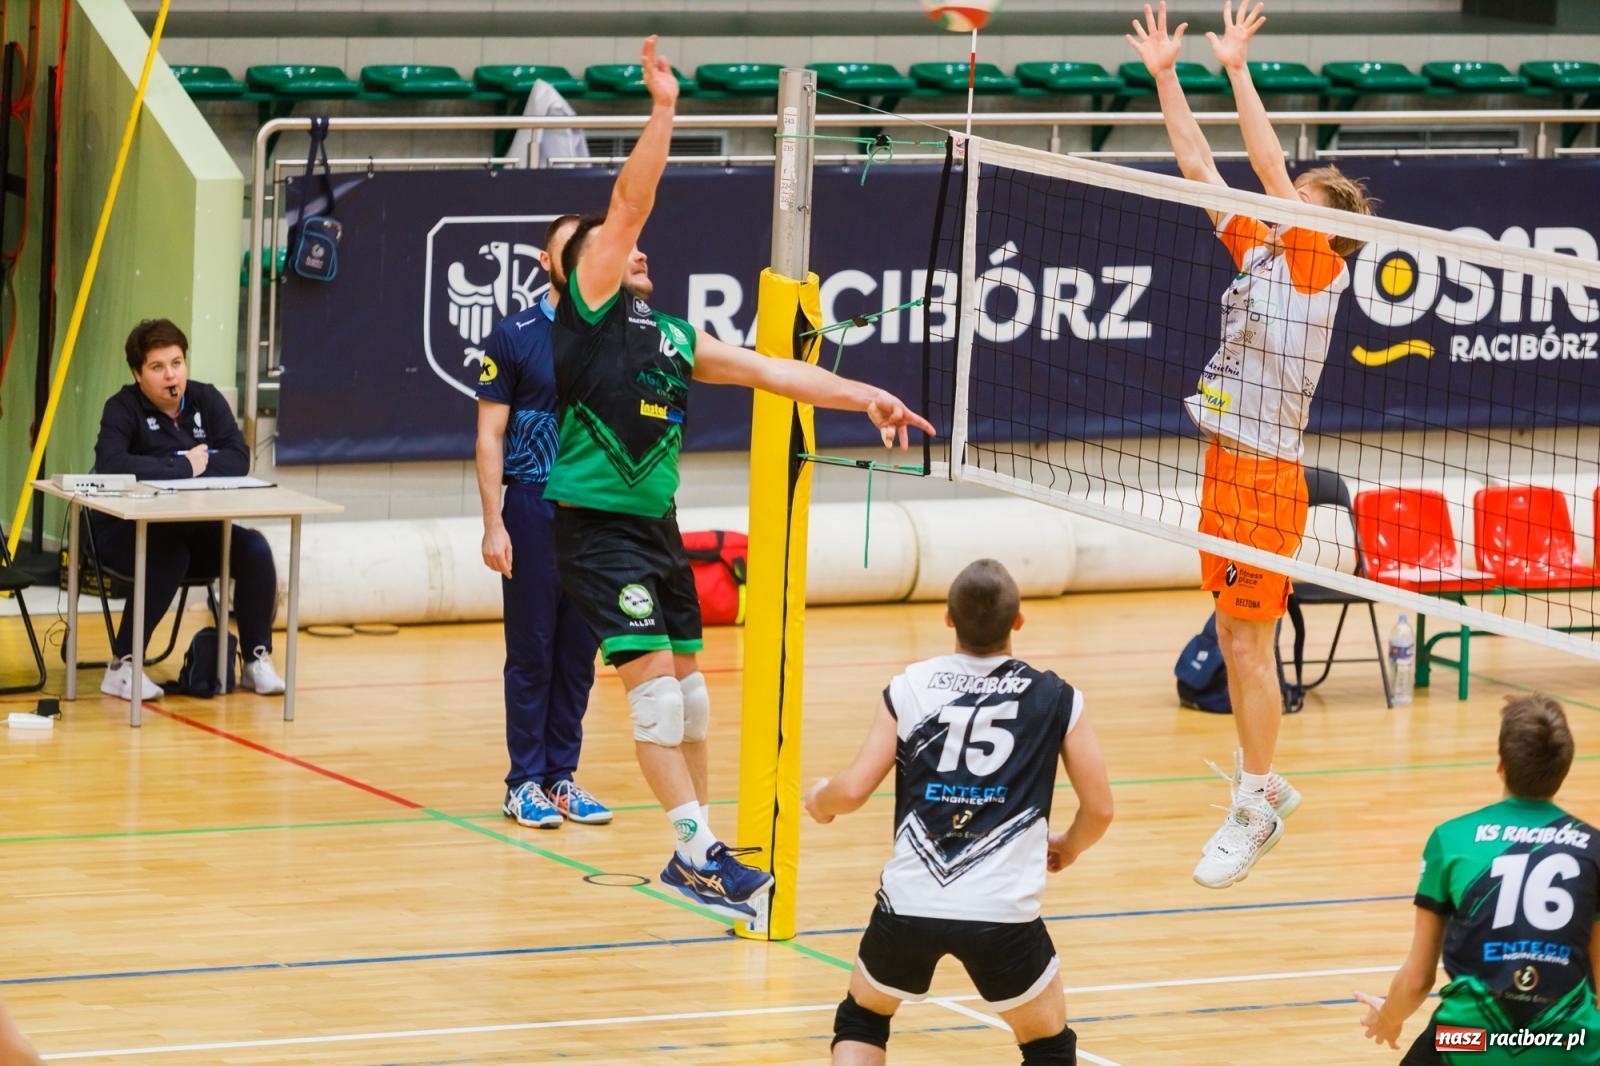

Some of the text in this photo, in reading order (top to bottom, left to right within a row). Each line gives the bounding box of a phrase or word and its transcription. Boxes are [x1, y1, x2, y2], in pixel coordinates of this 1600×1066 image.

[688, 240, 1153, 347] RCIBÓRZ
[1451, 325, 1599, 362] RACIBÓRZ
[928, 670, 1032, 695] KS RACIBÓRZ
[936, 700, 1019, 777] 15
[1474, 821, 1591, 849] KS RACIBÓRZ
[1490, 853, 1581, 931] 16
